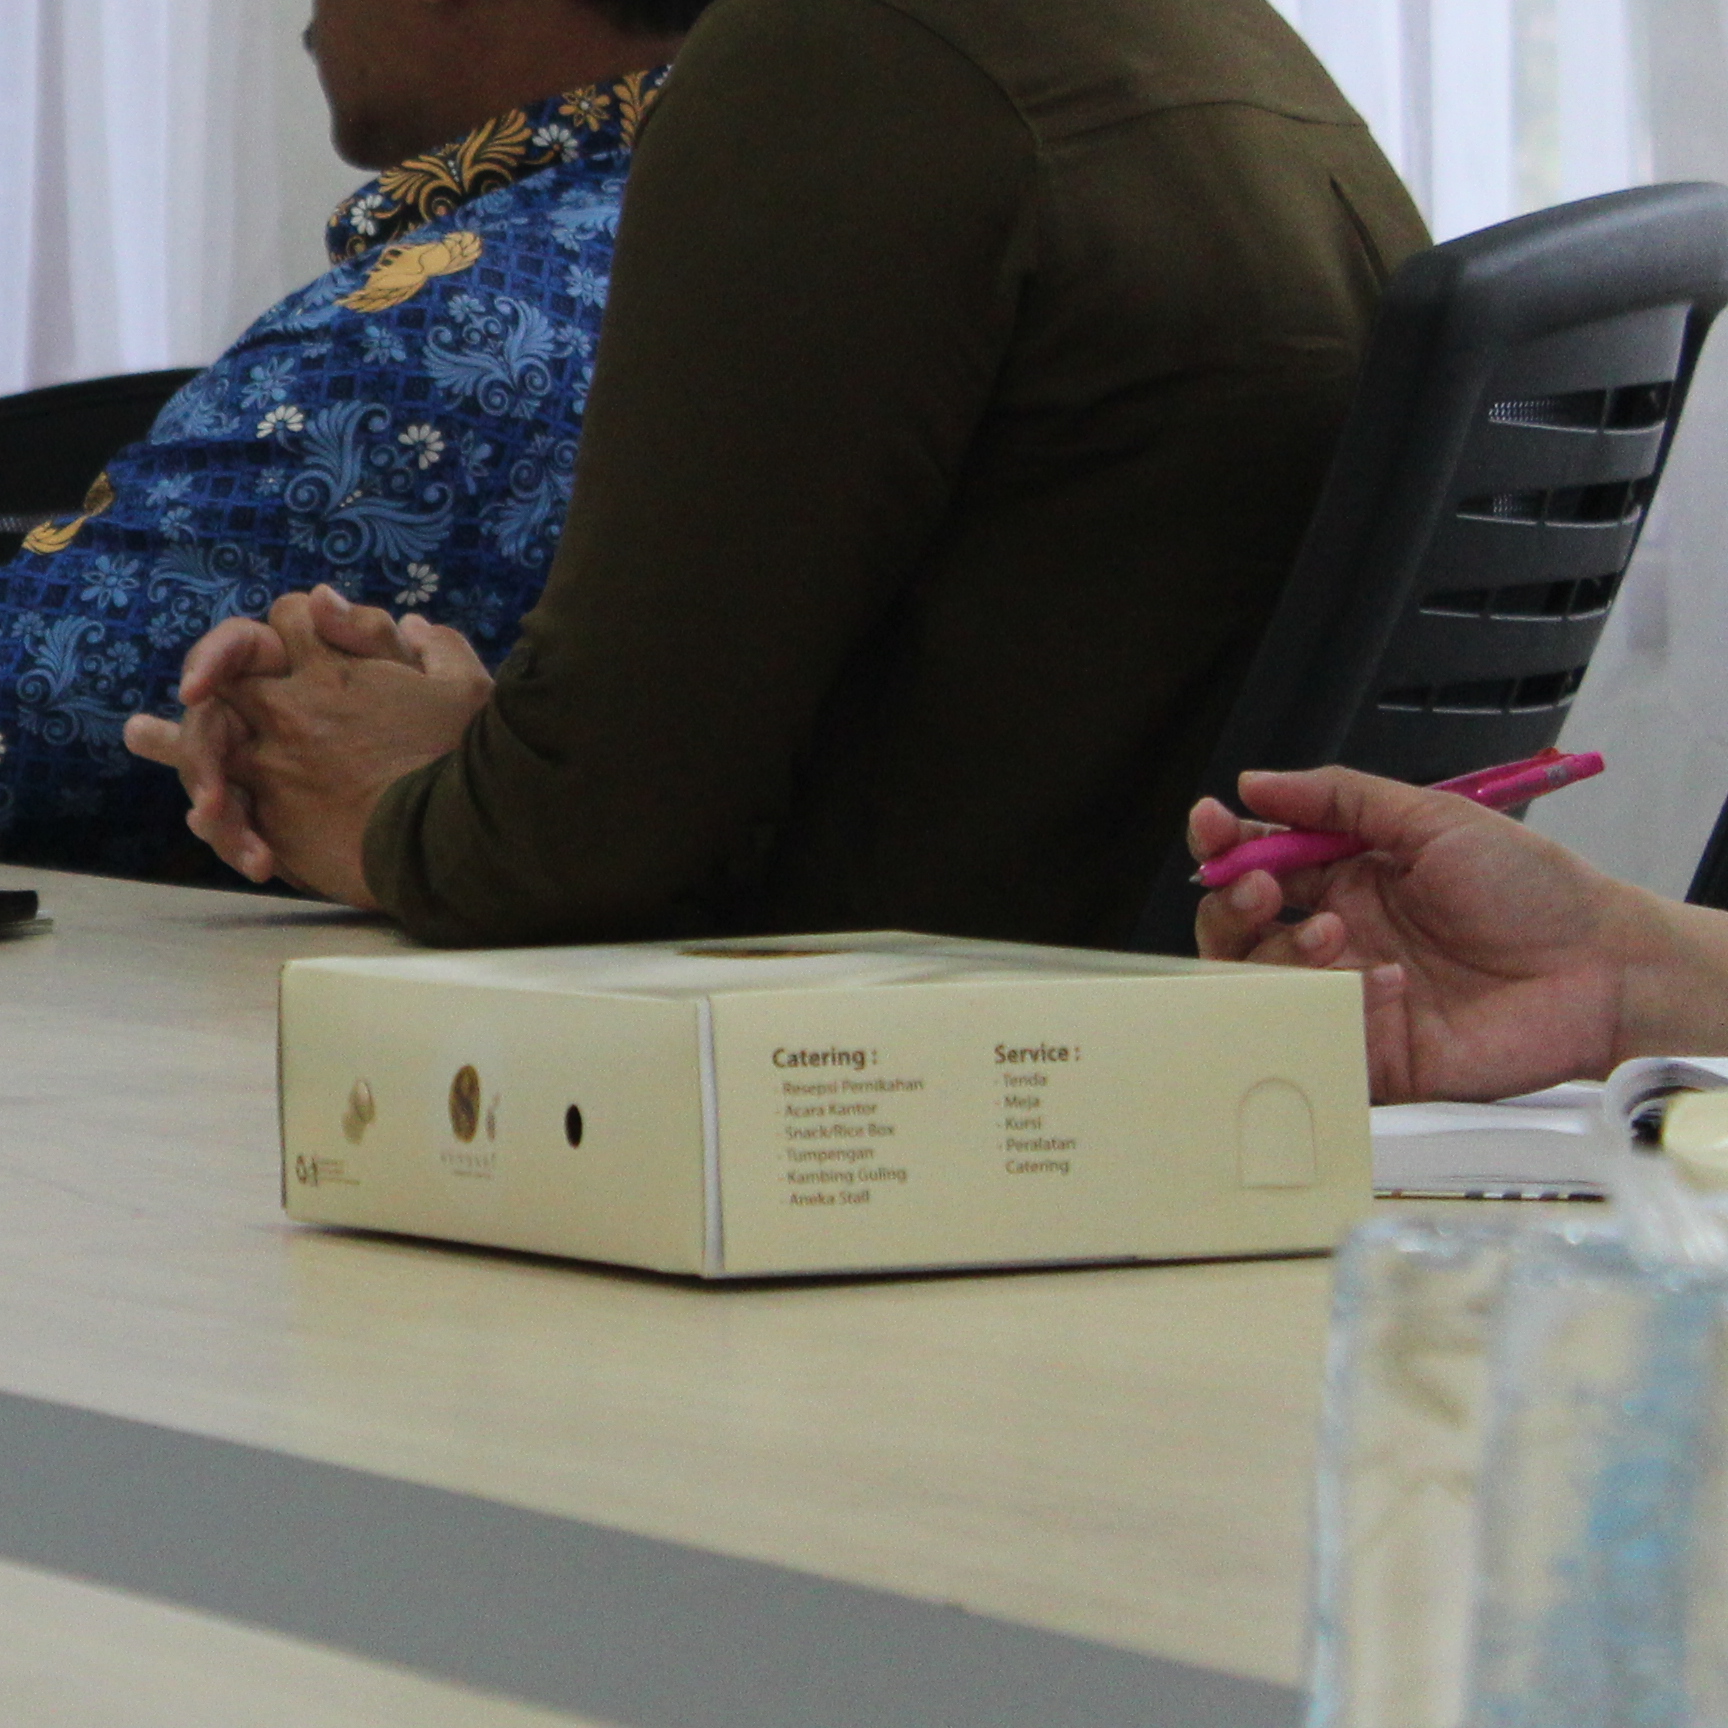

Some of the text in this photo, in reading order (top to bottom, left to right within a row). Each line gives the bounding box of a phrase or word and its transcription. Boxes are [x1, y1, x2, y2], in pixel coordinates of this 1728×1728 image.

[772, 1046, 866, 1071] Catering
[994, 1041, 1070, 1065] Service
[1003, 1072, 1048, 1088] Tenda
[1003, 1095, 1041, 1110] Meja
